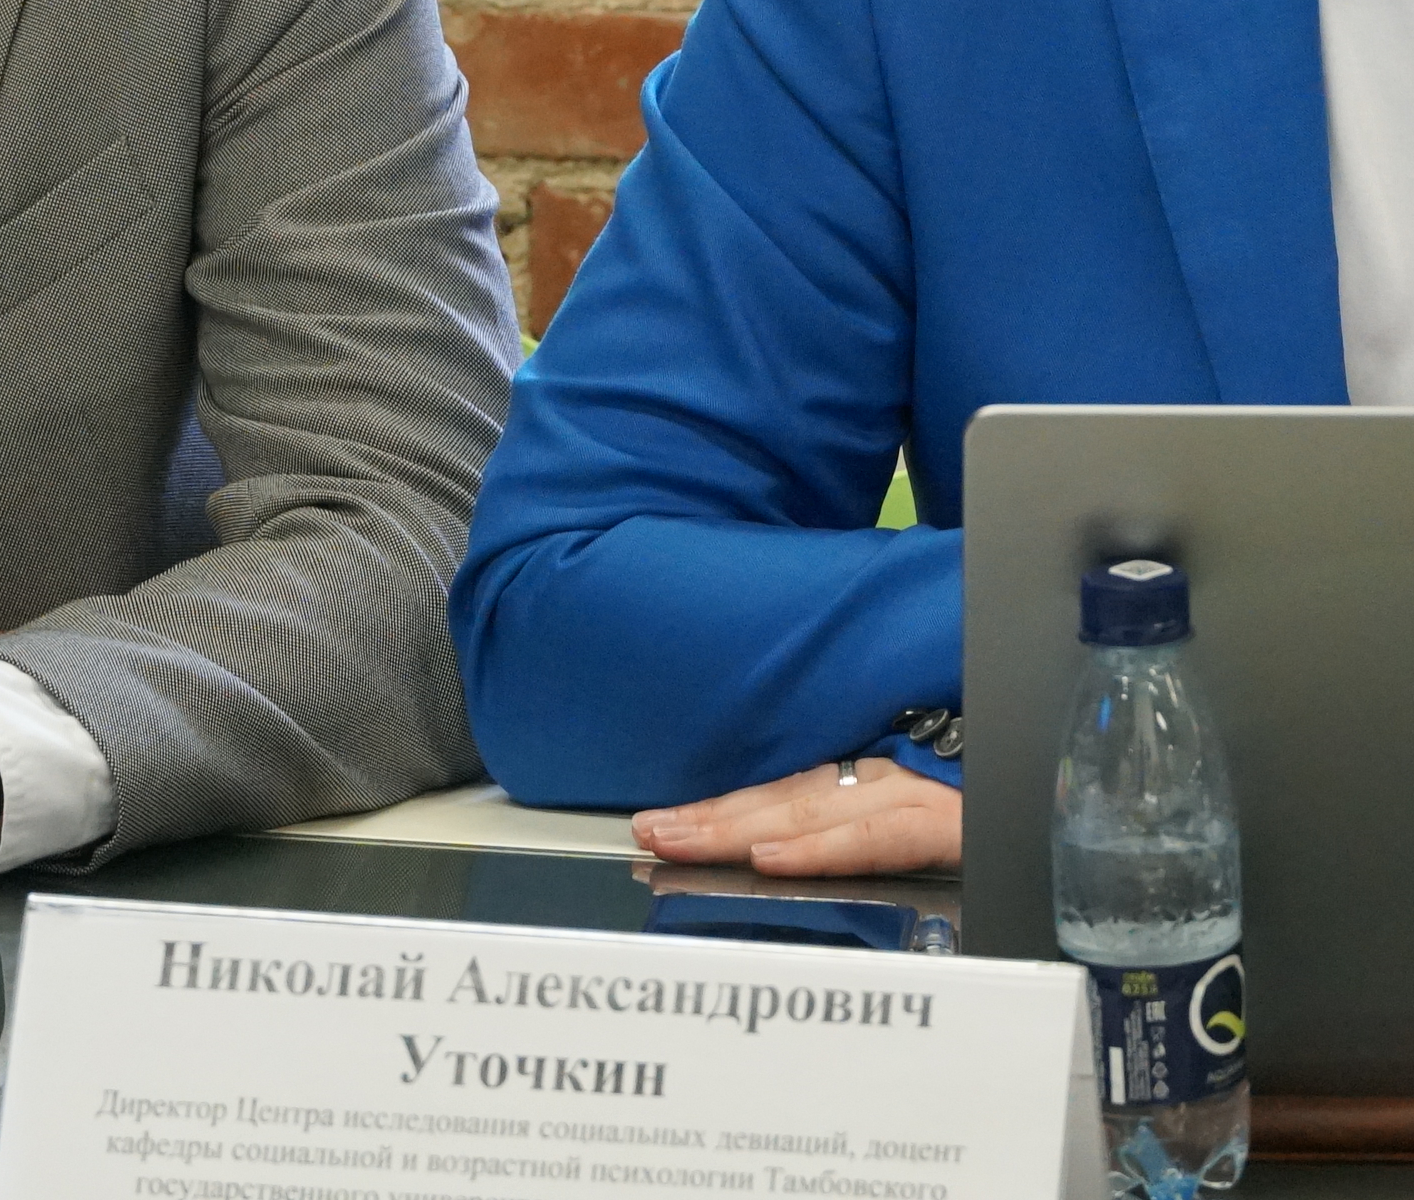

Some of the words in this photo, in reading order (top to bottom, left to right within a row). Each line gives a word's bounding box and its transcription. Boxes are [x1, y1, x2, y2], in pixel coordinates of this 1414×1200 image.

[155, 940, 427, 1001] Николай
[446, 954, 937, 1034] Александрович
[399, 1033, 668, 1098] Уточкин
[94, 1087, 228, 1128] Директор
[235, 1096, 334, 1133] Центра
[342, 1109, 530, 1138] исследования
[538, 1120, 706, 1149] социальных
[715, 1130, 856, 1161] девиаций,
[862, 1138, 969, 1163] доцент
[105, 1129, 224, 1166] кафедры
[230, 1140, 393, 1170] социальной
[400, 1152, 419, 1172] и
[426, 1153, 582, 1181] возрастной
[589, 1162, 755, 1191] психологии
[762, 1165, 950, 1200] Тамбовского
